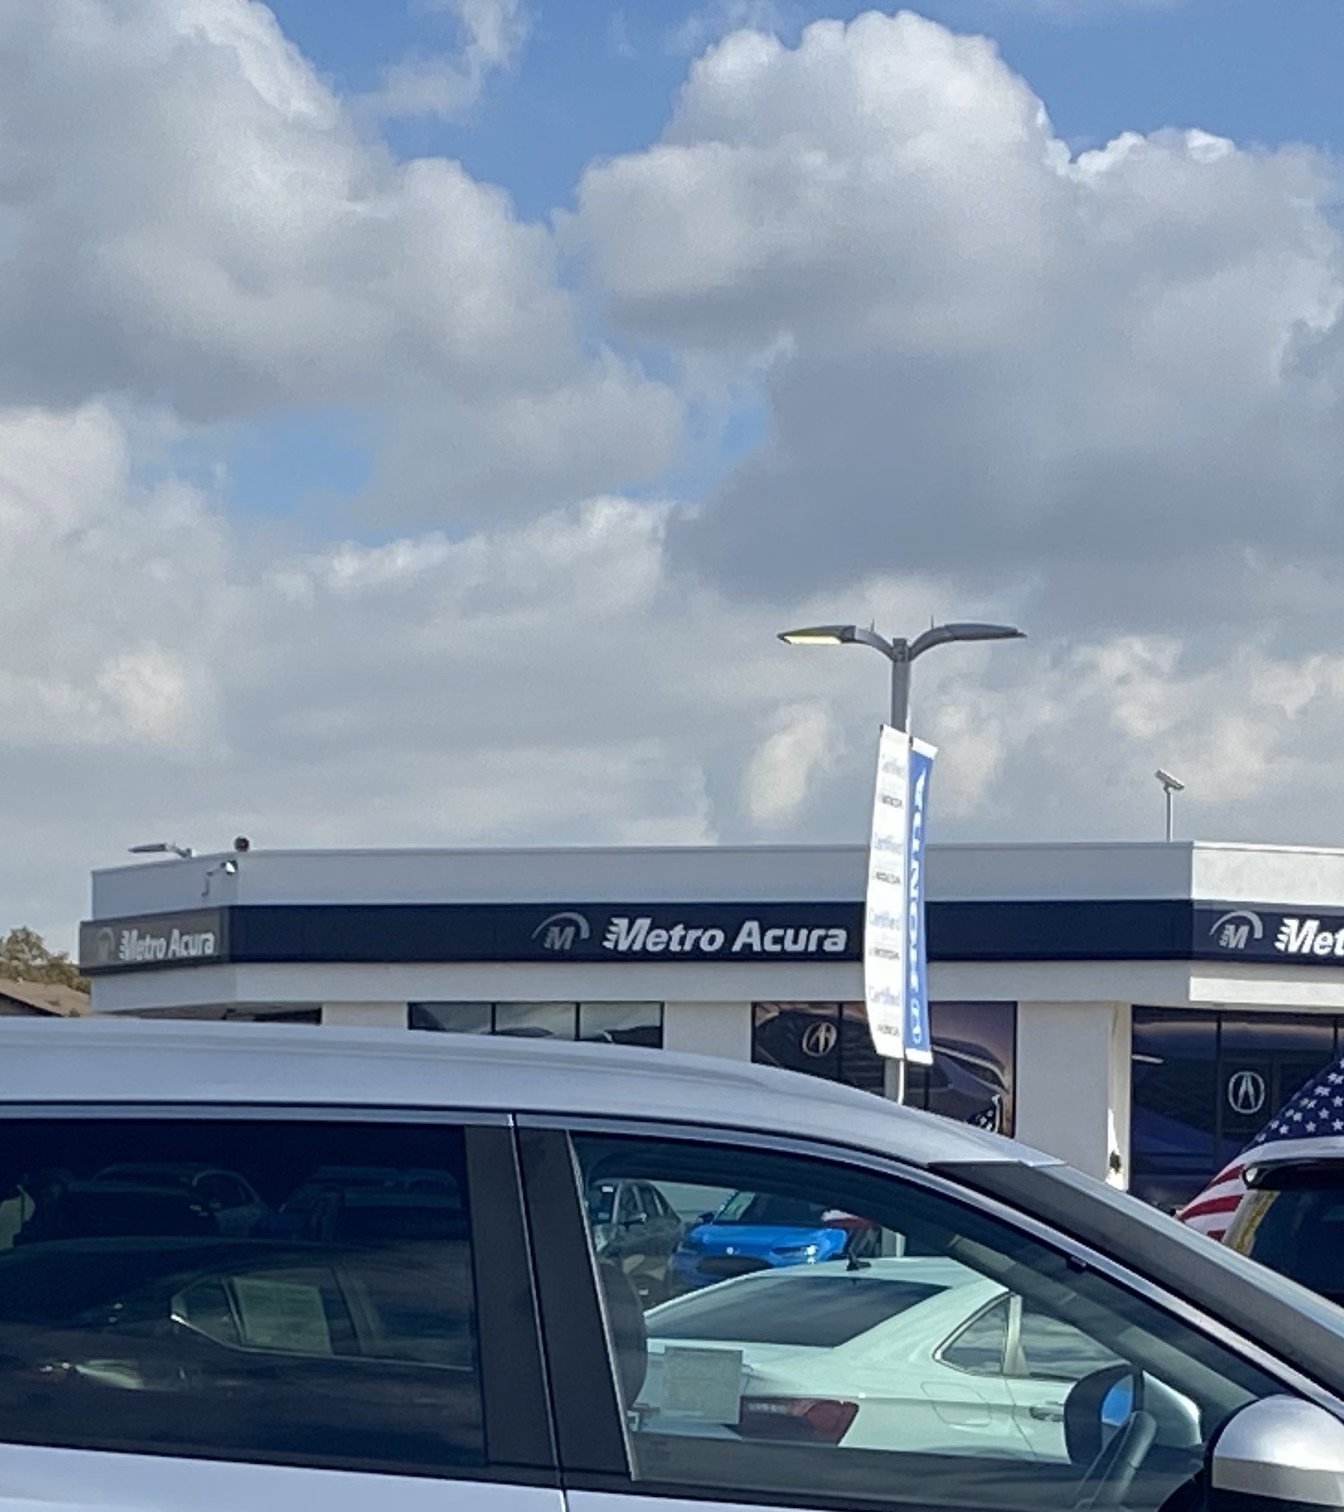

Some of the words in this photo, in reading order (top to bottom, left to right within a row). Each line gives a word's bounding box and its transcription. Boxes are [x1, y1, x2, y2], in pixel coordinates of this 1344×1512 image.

[119, 929, 167, 961] Metro
[168, 928, 215, 959] Acura
[602, 917, 725, 952] Metro
[731, 919, 848, 952] Acura
